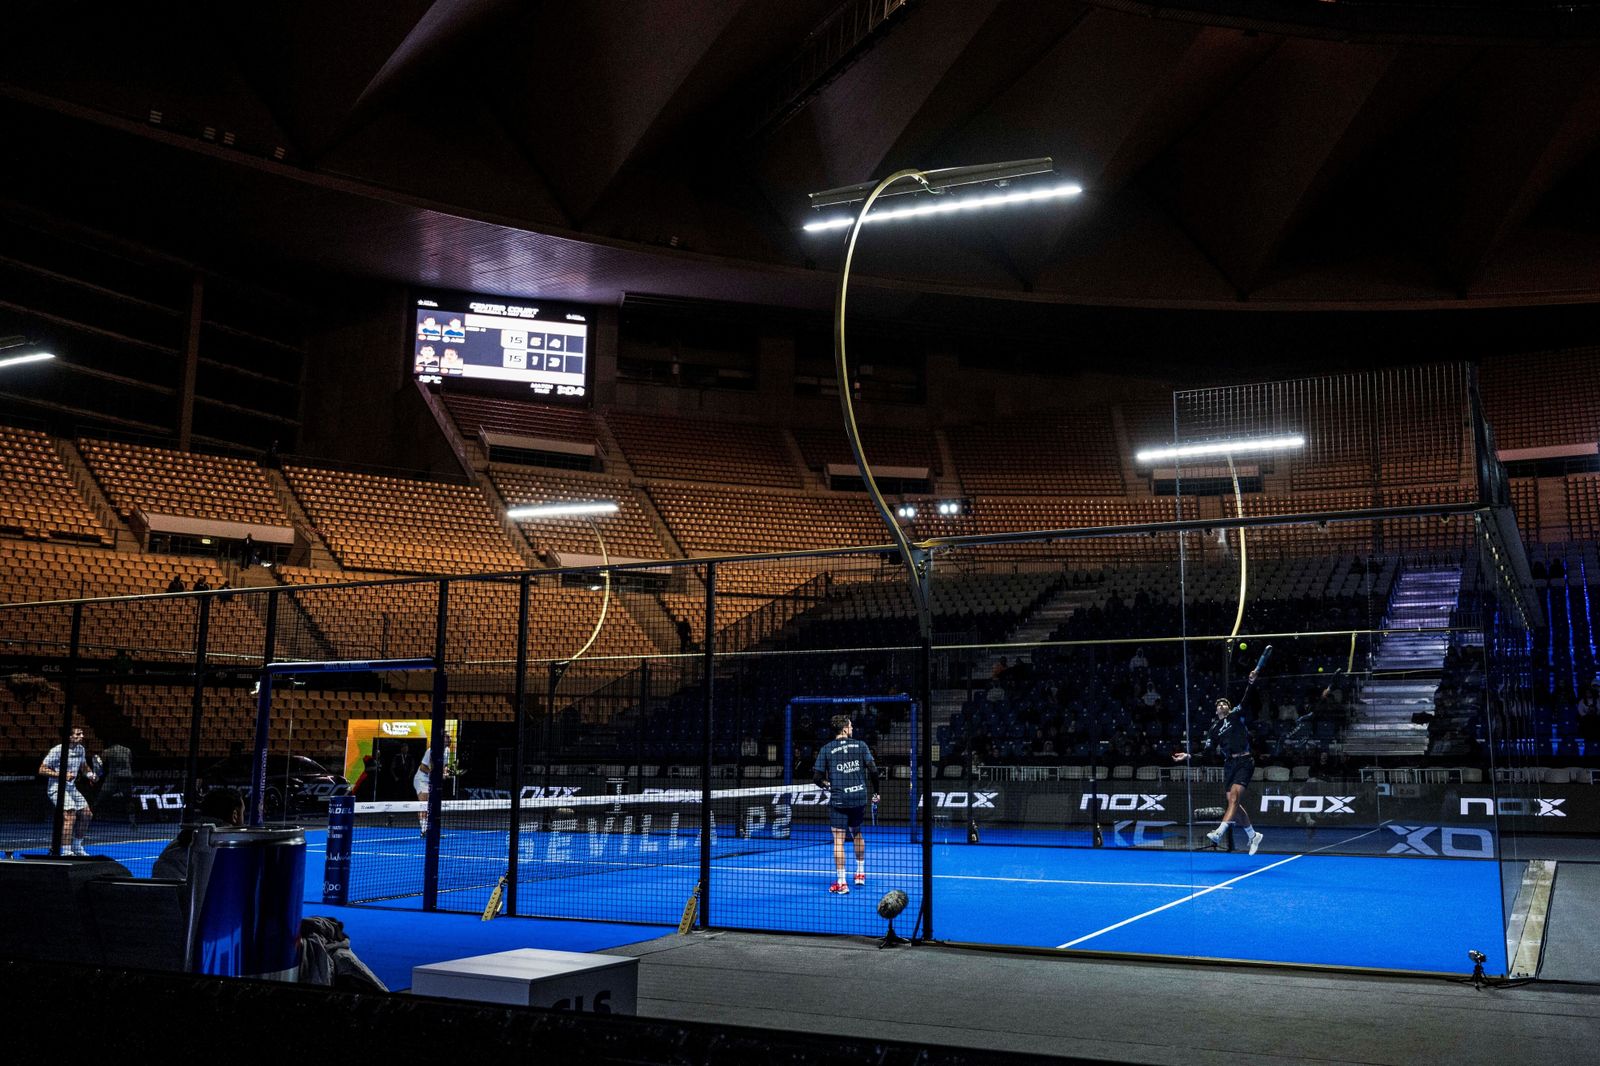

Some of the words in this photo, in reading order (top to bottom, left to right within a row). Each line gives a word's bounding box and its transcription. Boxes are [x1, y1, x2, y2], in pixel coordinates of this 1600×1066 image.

[510, 336, 523, 344] 15
[549, 338, 561, 348] 4
[509, 354, 522, 363] 15
[532, 355, 539, 365] 1
[548, 357, 560, 367] 3
[837, 760, 860, 771] QATAR
[140, 793, 186, 810] no
[743, 804, 792, 841] P2
